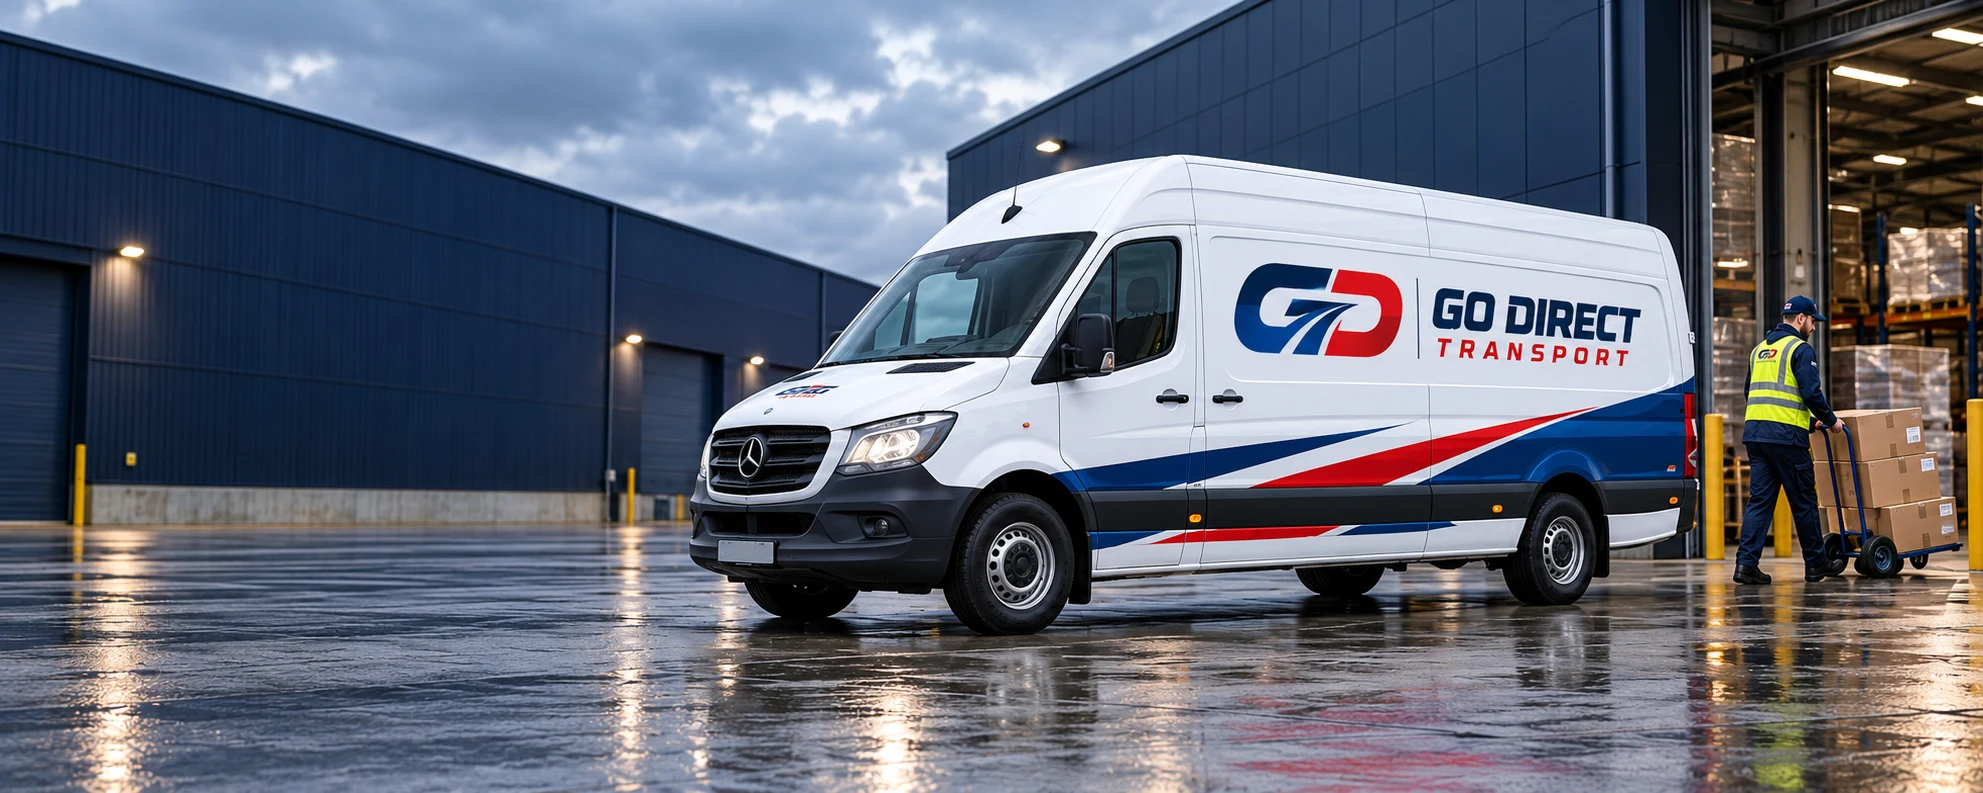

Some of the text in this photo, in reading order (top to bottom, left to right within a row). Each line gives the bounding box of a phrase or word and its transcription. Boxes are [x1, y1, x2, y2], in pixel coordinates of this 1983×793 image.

[1432, 288, 1641, 343] GO DIRECT
[1437, 338, 1629, 366] TRANSPORT
